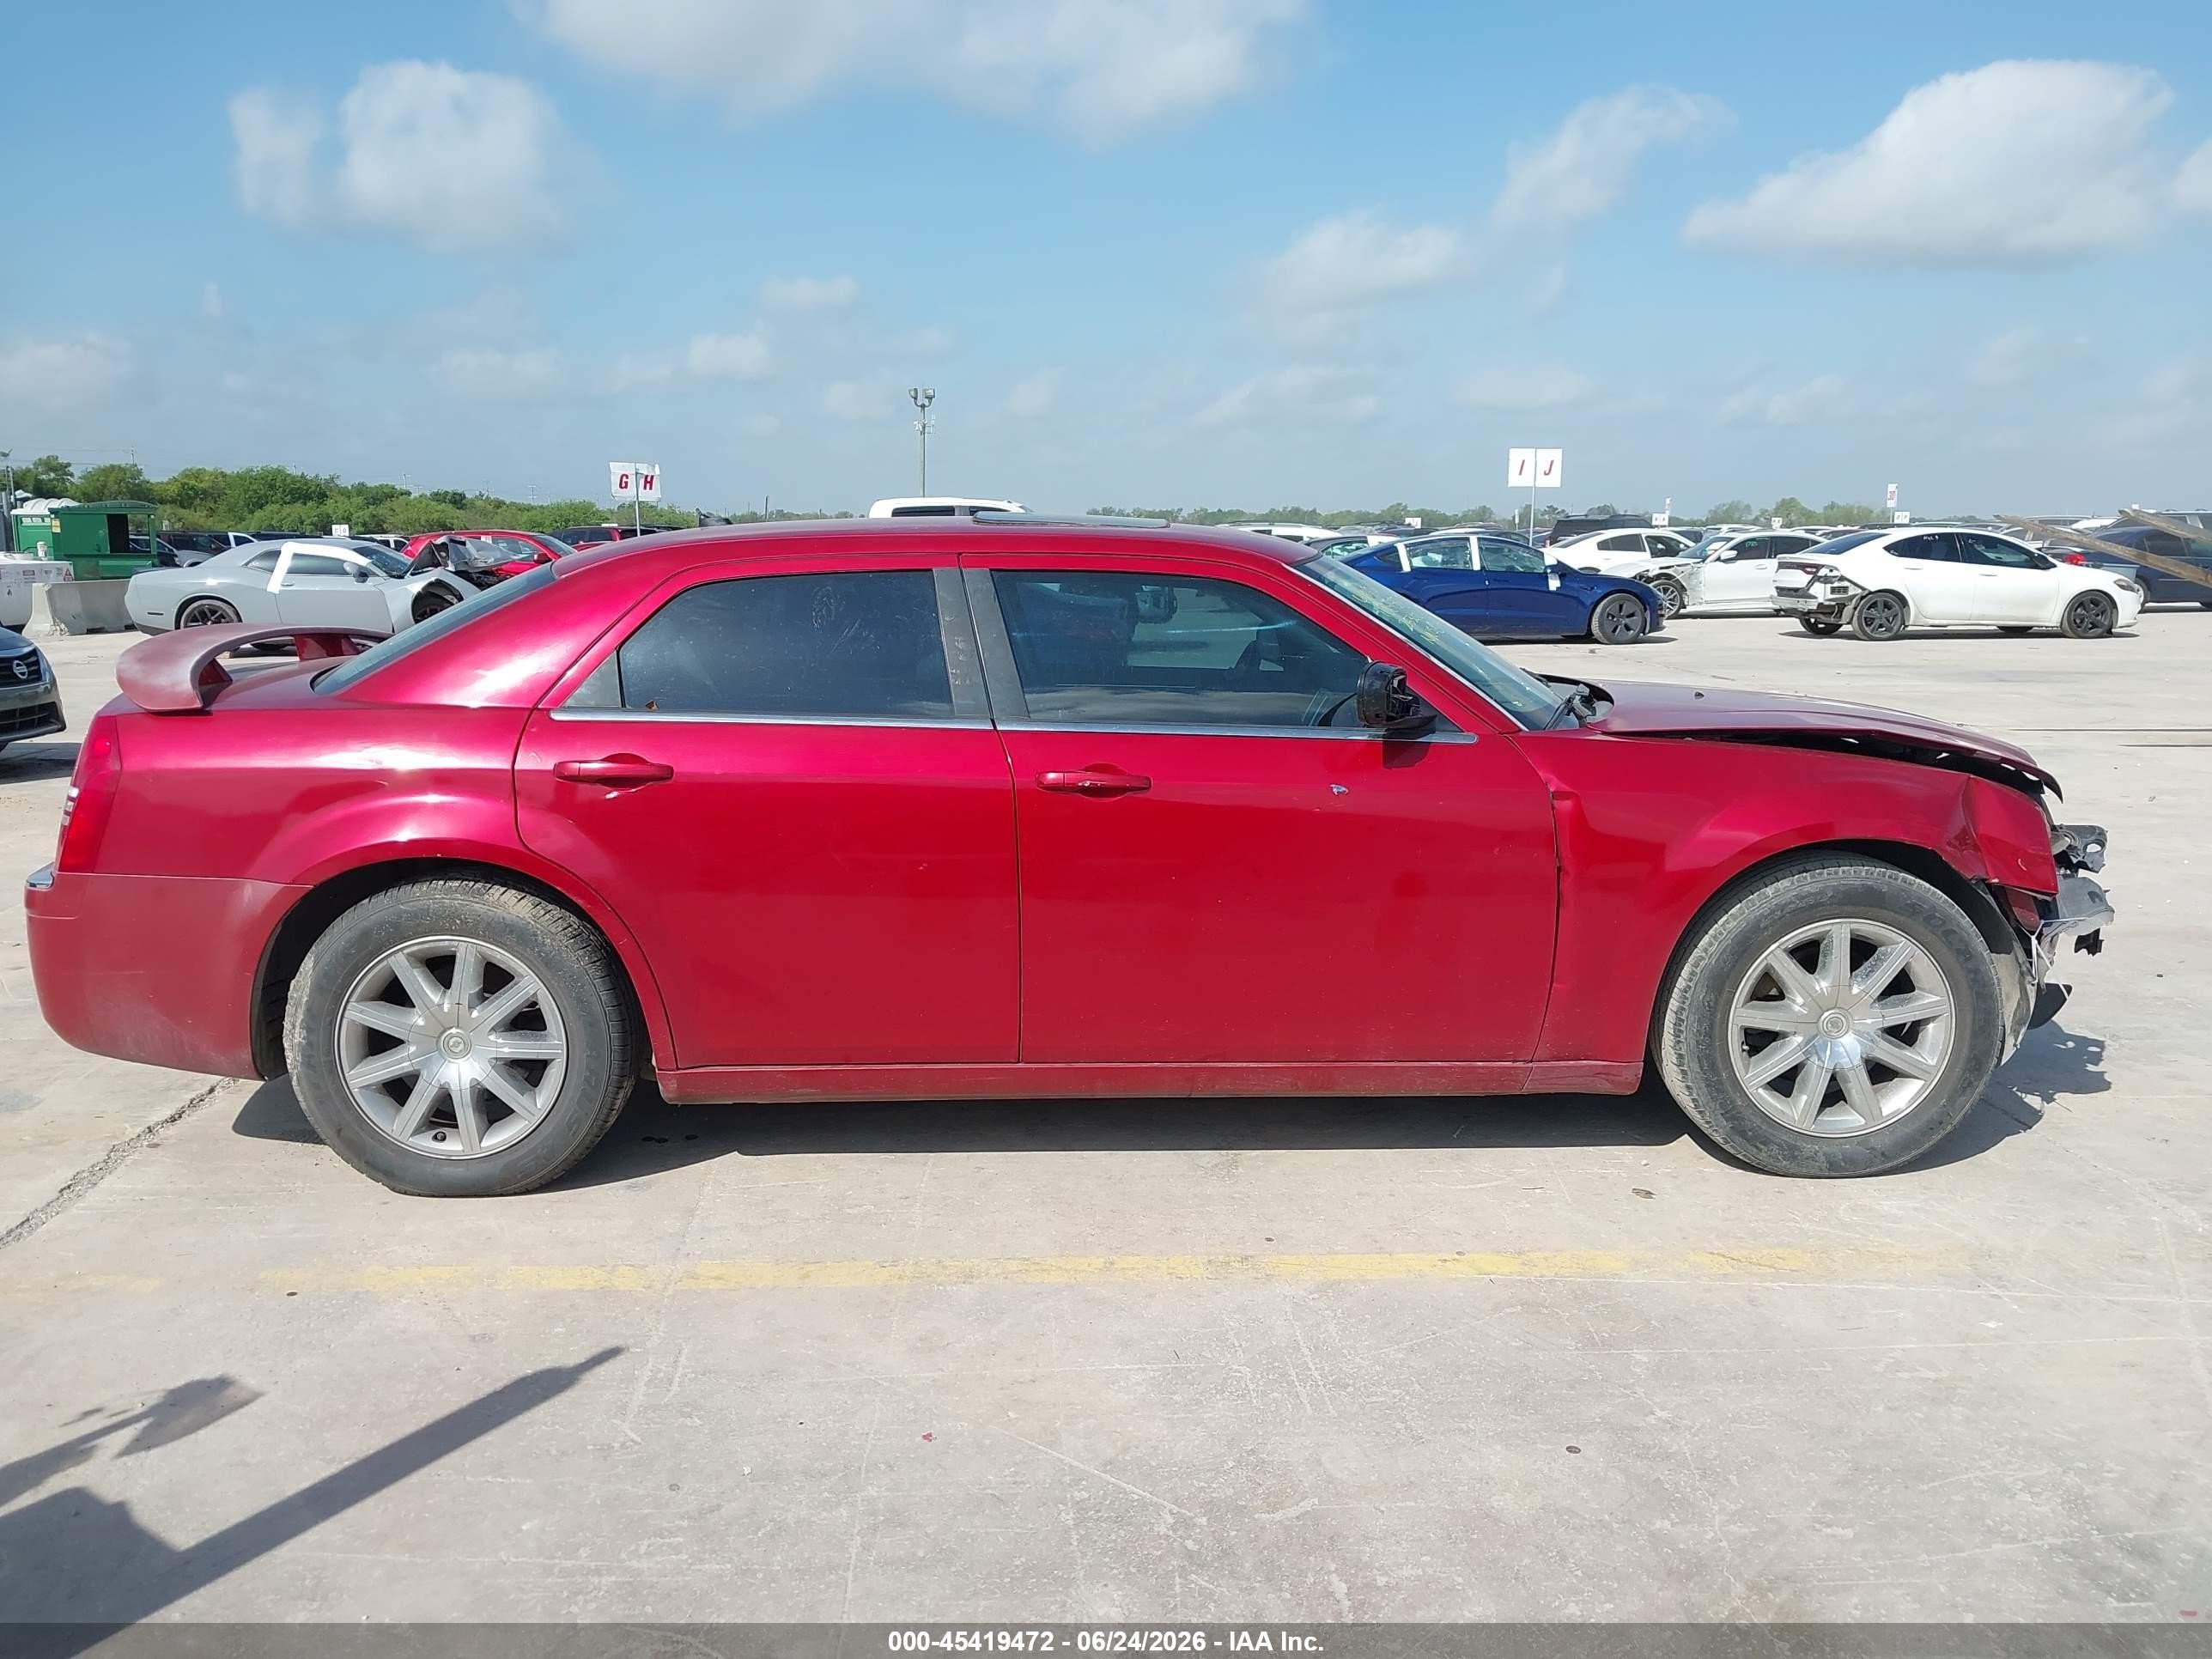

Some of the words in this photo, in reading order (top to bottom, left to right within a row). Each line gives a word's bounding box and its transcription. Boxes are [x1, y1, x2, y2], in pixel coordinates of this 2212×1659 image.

[1543, 459, 1554, 476] J
[618, 473, 629, 489] G
[643, 474, 655, 490] H
